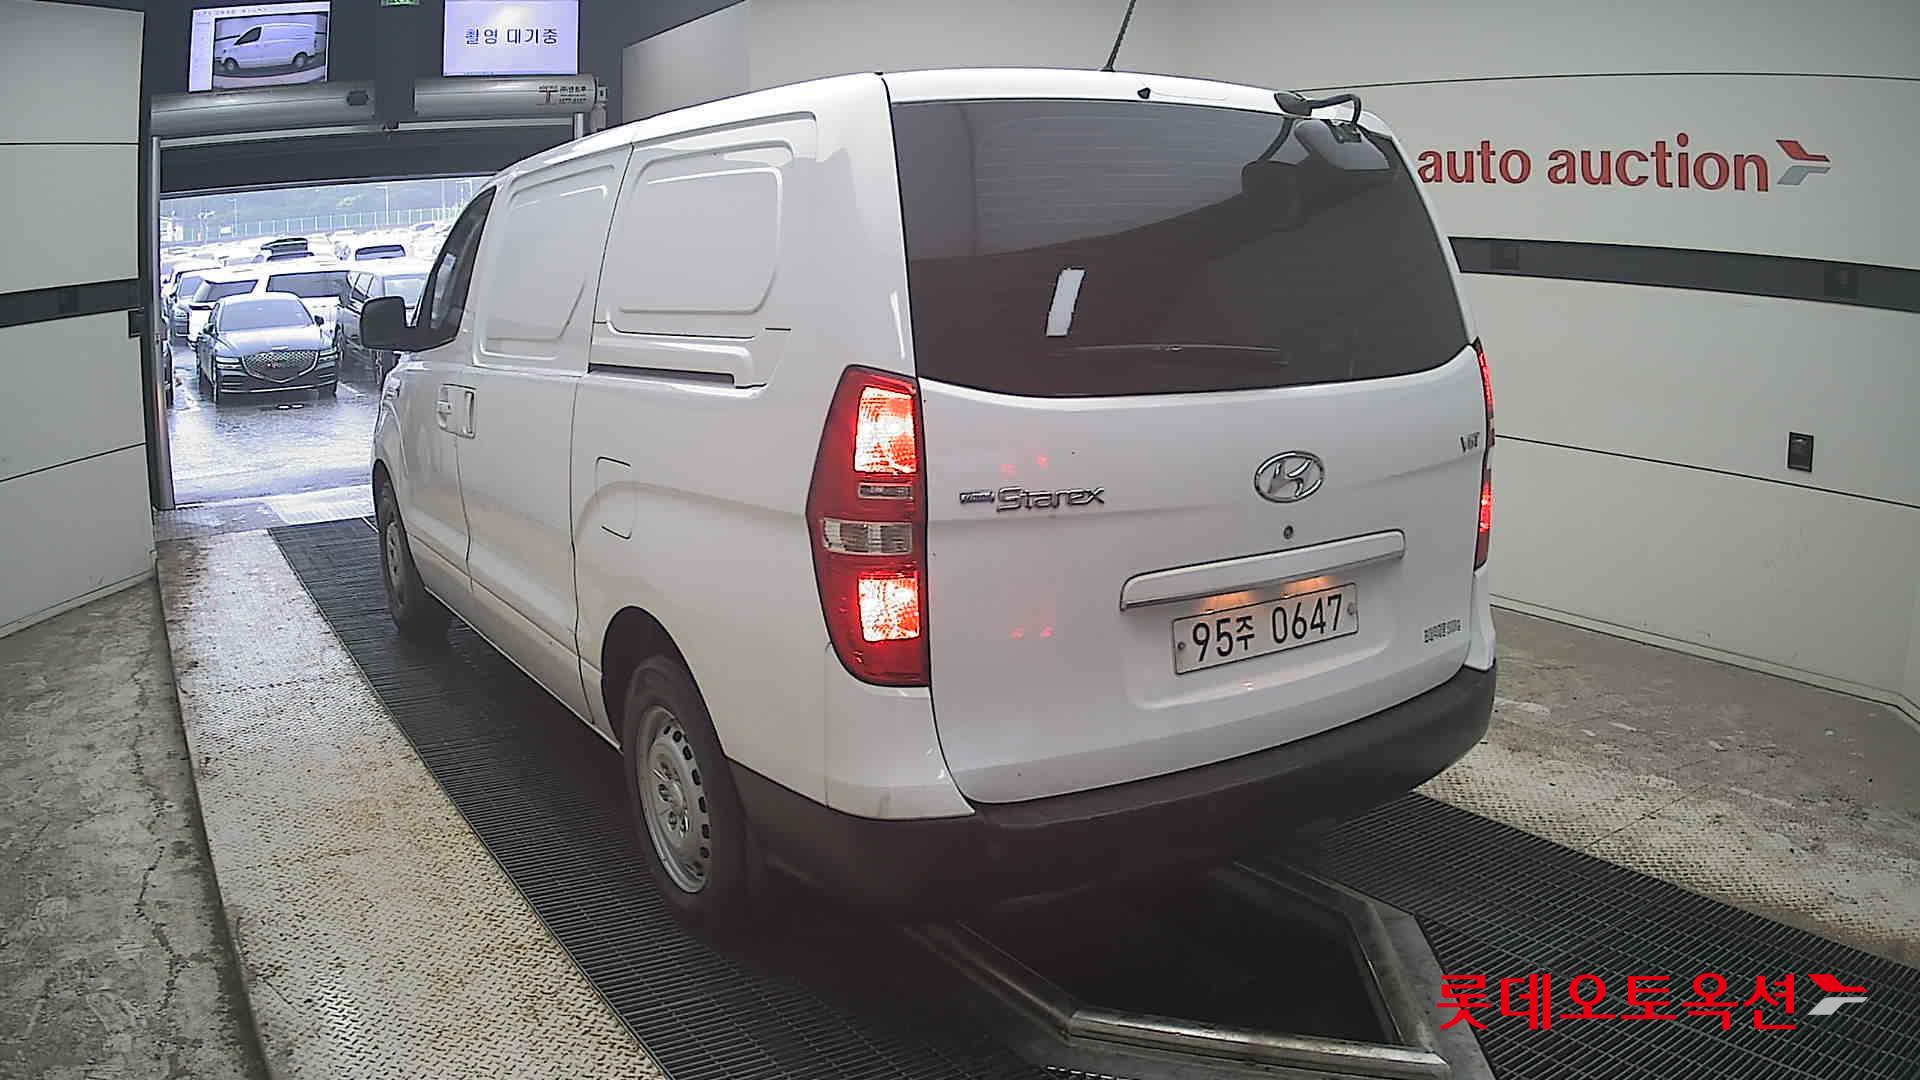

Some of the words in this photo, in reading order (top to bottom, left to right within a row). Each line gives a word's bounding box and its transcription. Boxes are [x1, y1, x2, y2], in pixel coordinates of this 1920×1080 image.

[507, 28, 558, 45] 대기중
[1417, 140, 1532, 184] auto
[1547, 132, 1769, 192] auction
[996, 486, 1105, 512] Starex
[1192, 615, 1256, 662] 95주
[1271, 594, 1343, 644] 0647
